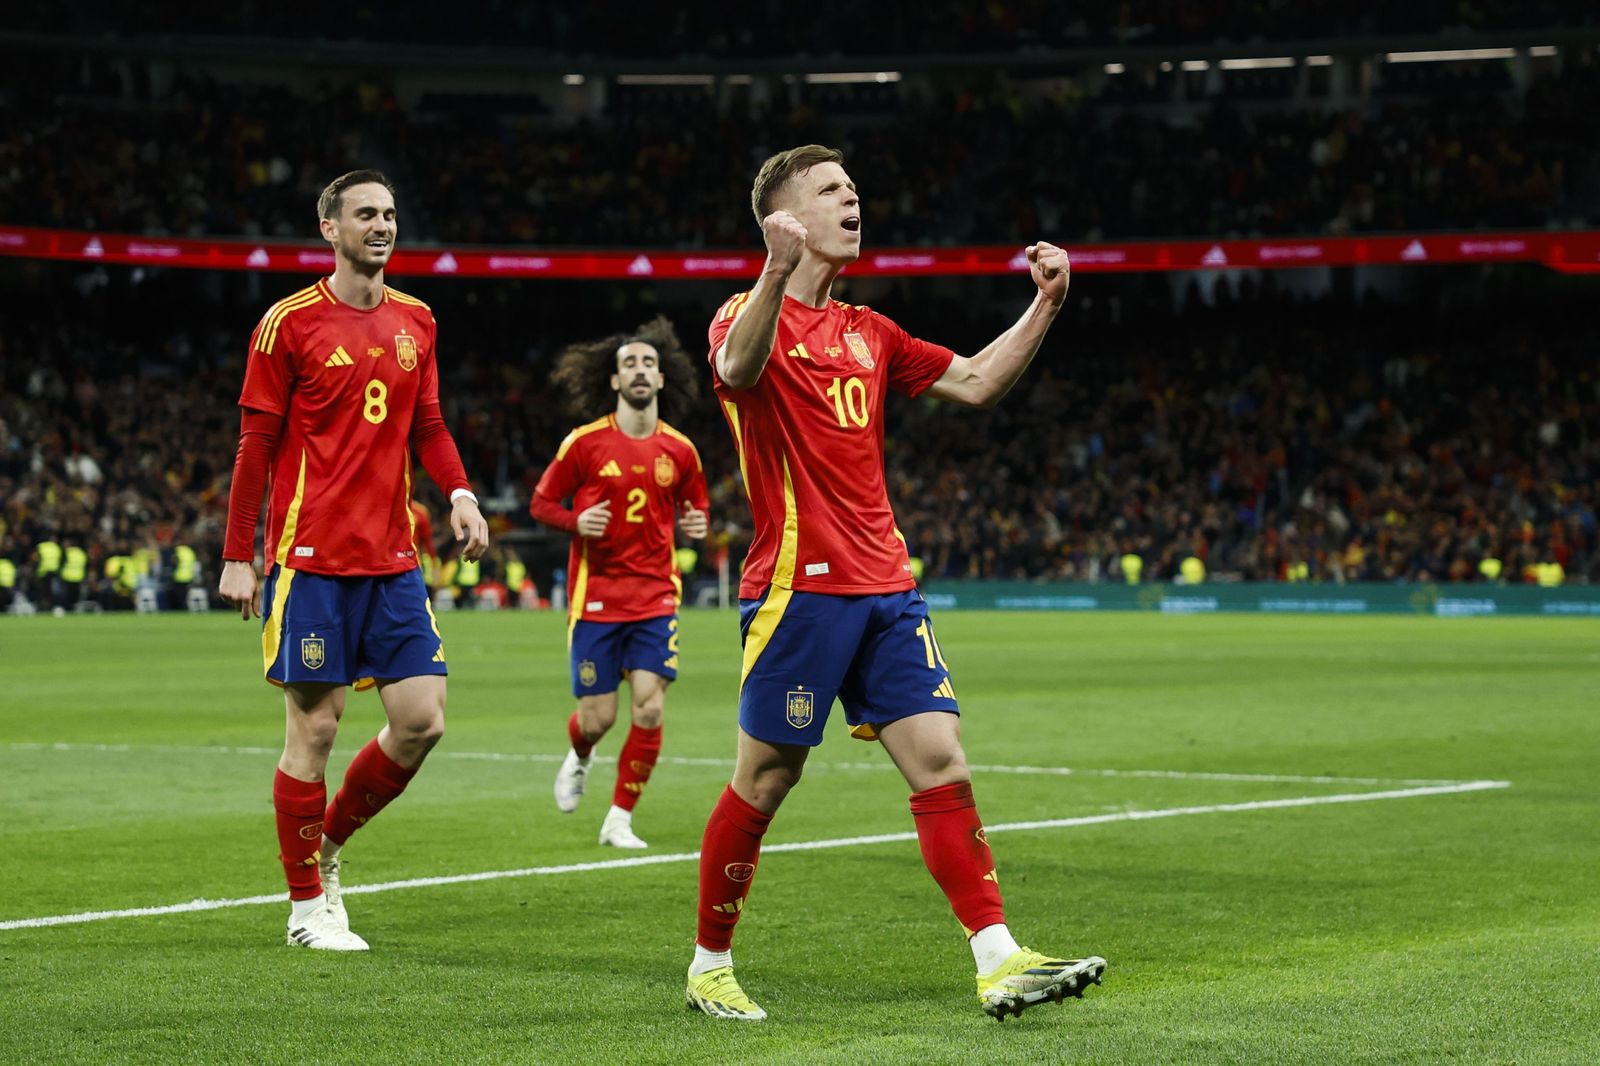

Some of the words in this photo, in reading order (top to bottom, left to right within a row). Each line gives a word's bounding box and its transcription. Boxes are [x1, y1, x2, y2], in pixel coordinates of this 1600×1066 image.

[363, 379, 388, 425] 8
[826, 376, 869, 428] 10
[626, 487, 647, 523] 2
